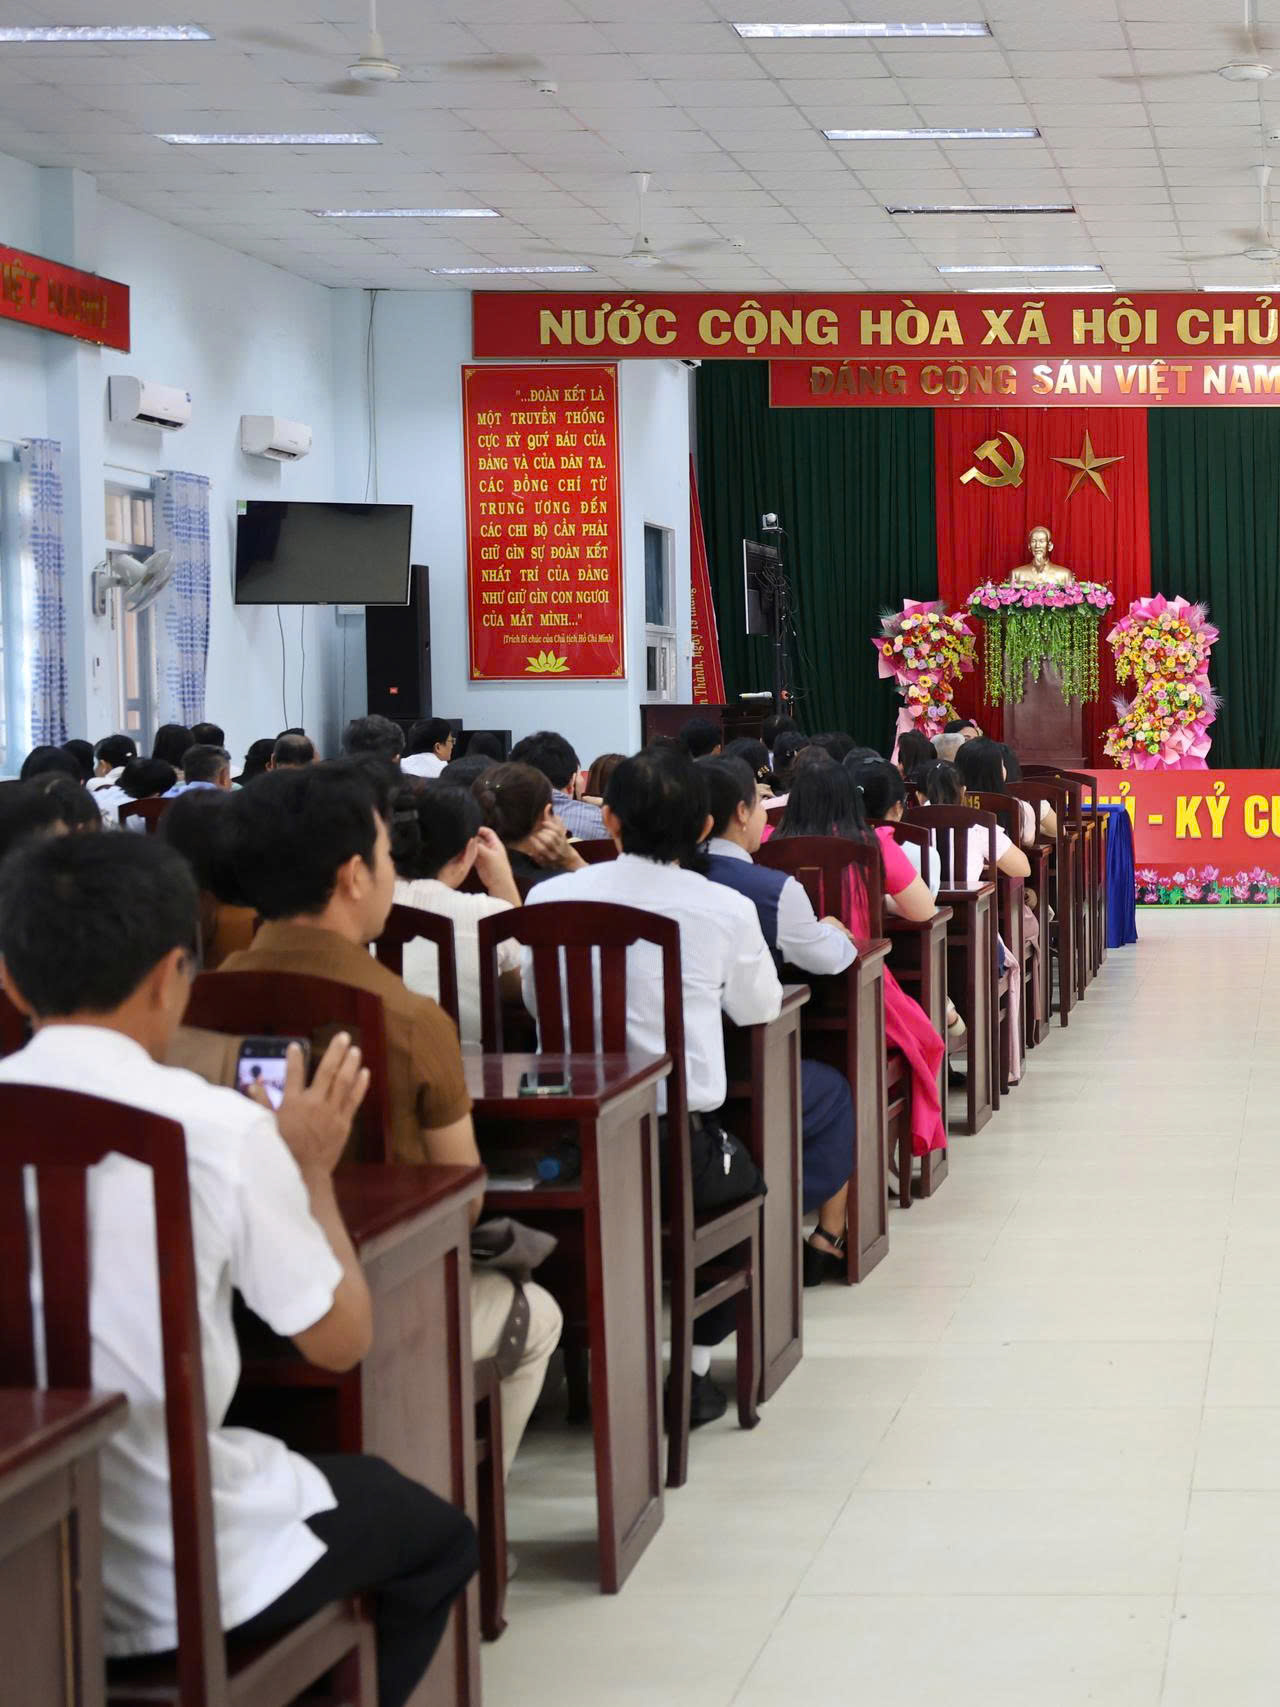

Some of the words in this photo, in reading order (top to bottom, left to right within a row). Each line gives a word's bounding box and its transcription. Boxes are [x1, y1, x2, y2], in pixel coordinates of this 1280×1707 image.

[540, 301, 678, 346] NƯỚC
[698, 301, 839, 352] CỘNG
[860, 300, 962, 346] HÒA
[980, 300, 1051, 345] XÃ
[1074, 298, 1157, 352] HỘI
[1177, 294, 1280, 344] CHỦ
[919, 360, 1017, 401] CỘNG
[1114, 359, 1193, 401] VIỆT
[564, 384, 586, 401] KẾT
[591, 386, 605, 401] LÀ
[477, 410, 501, 428] MỘT
[511, 406, 556, 424] TRUYỀN
[566, 407, 605, 424] THỐNG
[478, 434, 499, 451] CỰC
[506, 432, 522, 447] KỲ
[528, 432, 549, 451] QUÝ
[556, 431, 577, 446] BÁU
[584, 430, 606, 446] CỦA
[479, 454, 508, 470] ĐẢNG
[514, 454, 528, 469] VÀ
[534, 453, 555, 469] CỦA
[561, 454, 583, 469] DÂN
[479, 477, 504, 492] CÁC
[514, 474, 548, 492] ĐỒNG
[558, 476, 581, 491] CHÍ
[591, 476, 607, 491] TỪ
[480, 502, 524, 515] TRUNG
[535, 500, 570, 514] ƯƠNG
[581, 497, 607, 514] ĐẾN
[481, 522, 501, 537] CÁC
[508, 525, 527, 536] CHI
[534, 521, 548, 539] BỘ
[554, 518, 575, 536] CẦN
[582, 520, 607, 536] PHẢI
[481, 544, 499, 559] GIỮ
[506, 544, 524, 559] GÌN
[531, 545, 545, 562] SỰ
[551, 543, 579, 559] ĐOÀN
[586, 541, 608, 558] KẾT
[482, 564, 511, 582] NHẤT
[520, 566, 539, 581] TRÍ
[548, 566, 570, 581] CỦA
[578, 564, 608, 581] ĐẢNG
[482, 591, 505, 604] NHƯ
[508, 589, 526, 604] GIỮ
[530, 588, 548, 604] GÌN
[552, 591, 572, 603] CON
[576, 589, 609, 603] NGƯƠI
[483, 610, 504, 627] CỦA
[510, 608, 533, 626] MẮT
[1176, 781, 1230, 839] KỶ
